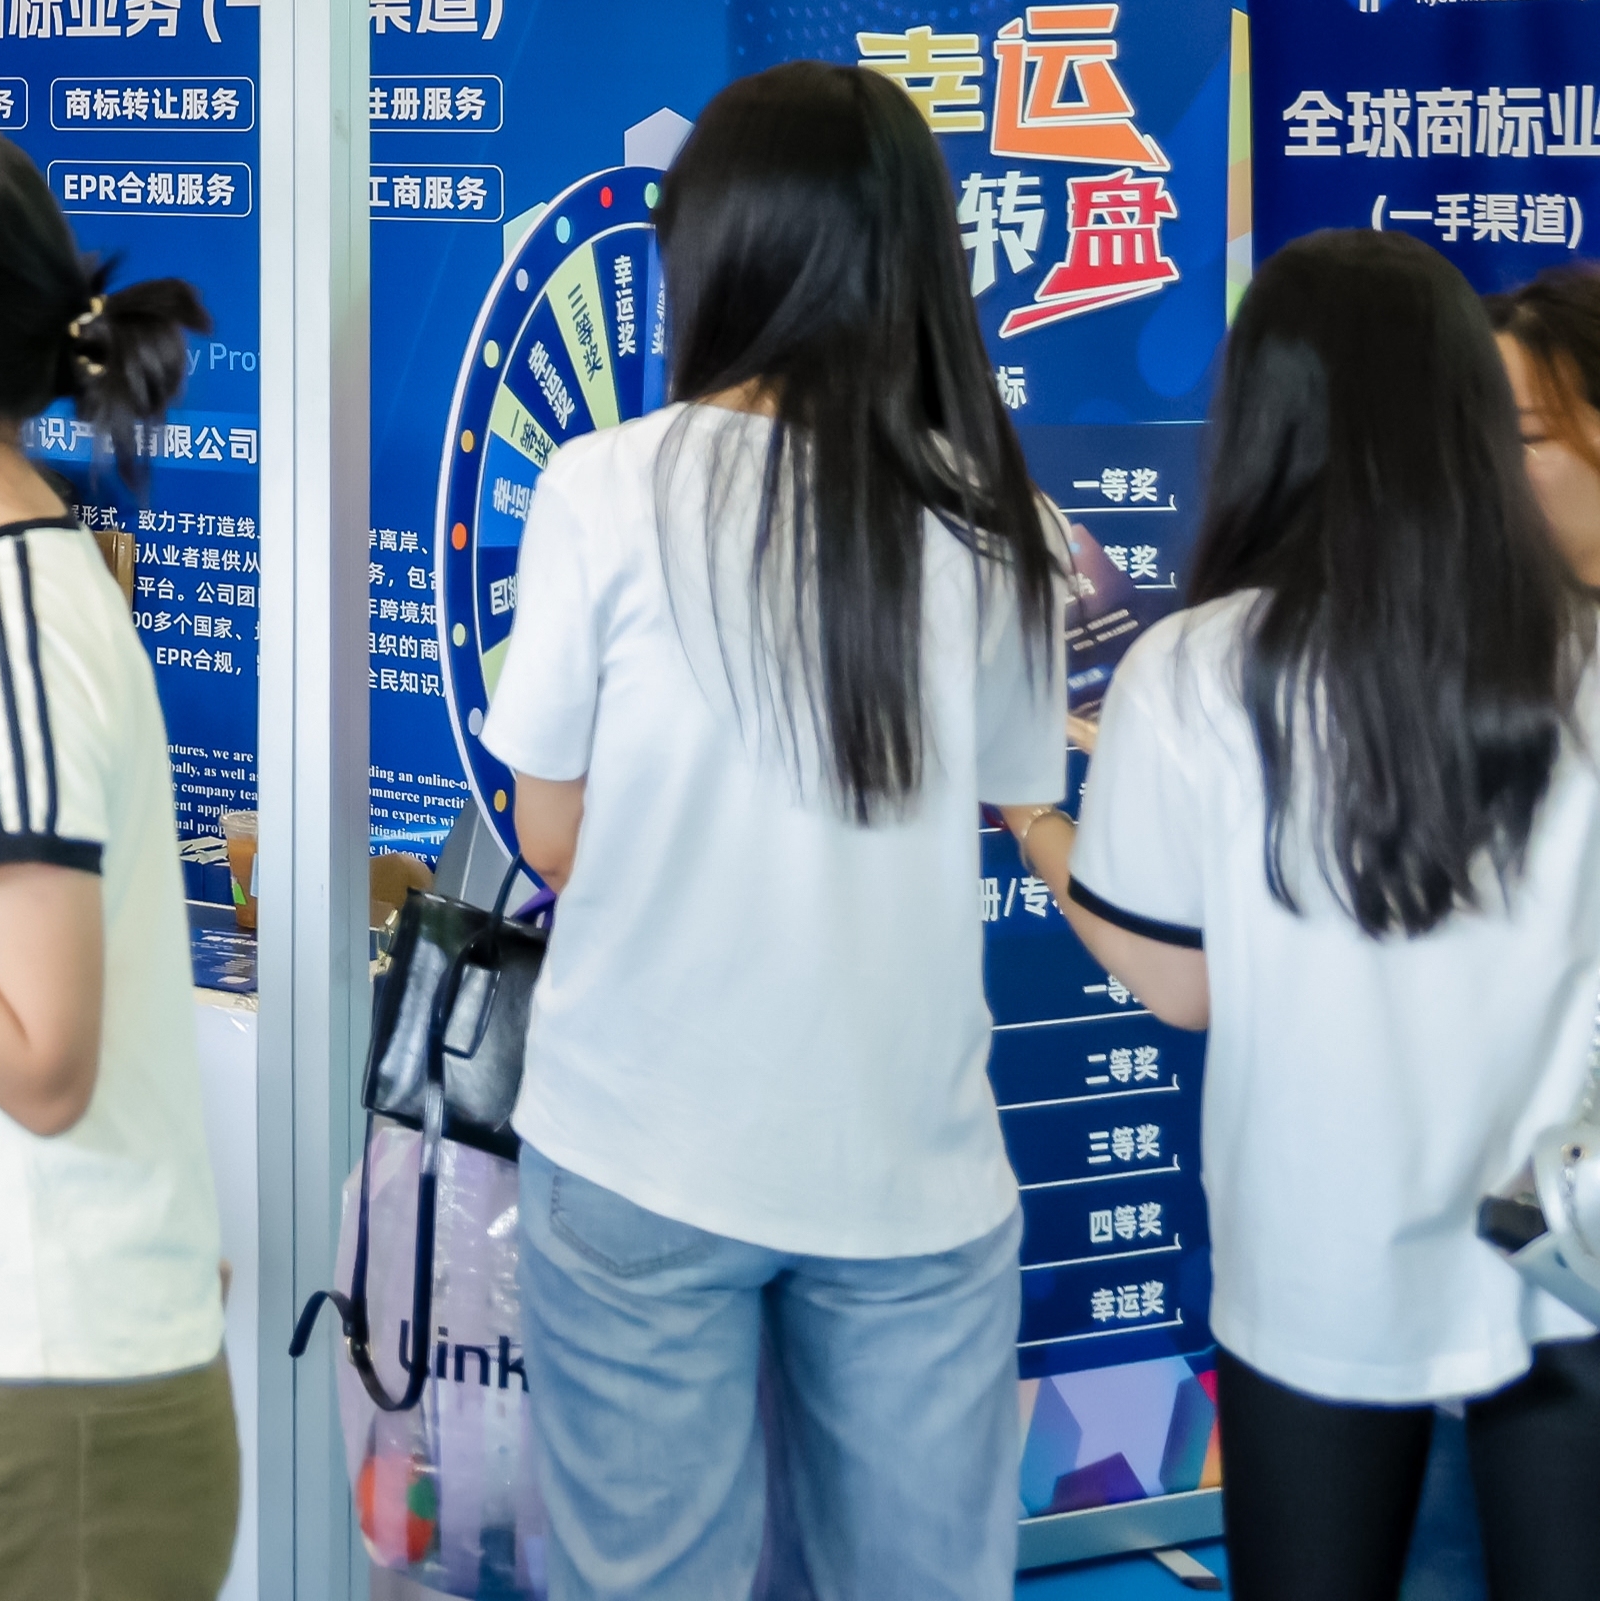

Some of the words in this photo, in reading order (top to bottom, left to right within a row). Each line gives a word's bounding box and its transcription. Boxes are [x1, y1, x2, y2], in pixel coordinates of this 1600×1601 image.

[65, 86, 240, 122] 商标转让服务
[63, 170, 236, 208] EPR合规服务
[614, 253, 636, 357] 幸运奖
[568, 283, 603, 382] 三等奖
[527, 340, 577, 430] 幸运奖
[1072, 467, 1159, 503] 一等奖
[212, 749, 229, 761] we
[233, 750, 254, 763] are
[220, 767, 246, 781] well
[181, 782, 235, 801] company
[398, 770, 414, 783] an
[417, 773, 471, 791] online-o
[392, 809, 437, 827] experts
[1085, 1045, 1160, 1085] 二等奖
[1087, 1123, 1161, 1164] 三等奖
[1089, 1201, 1163, 1244] 四等奖
[1090, 1279, 1165, 1323] 幸运奖
